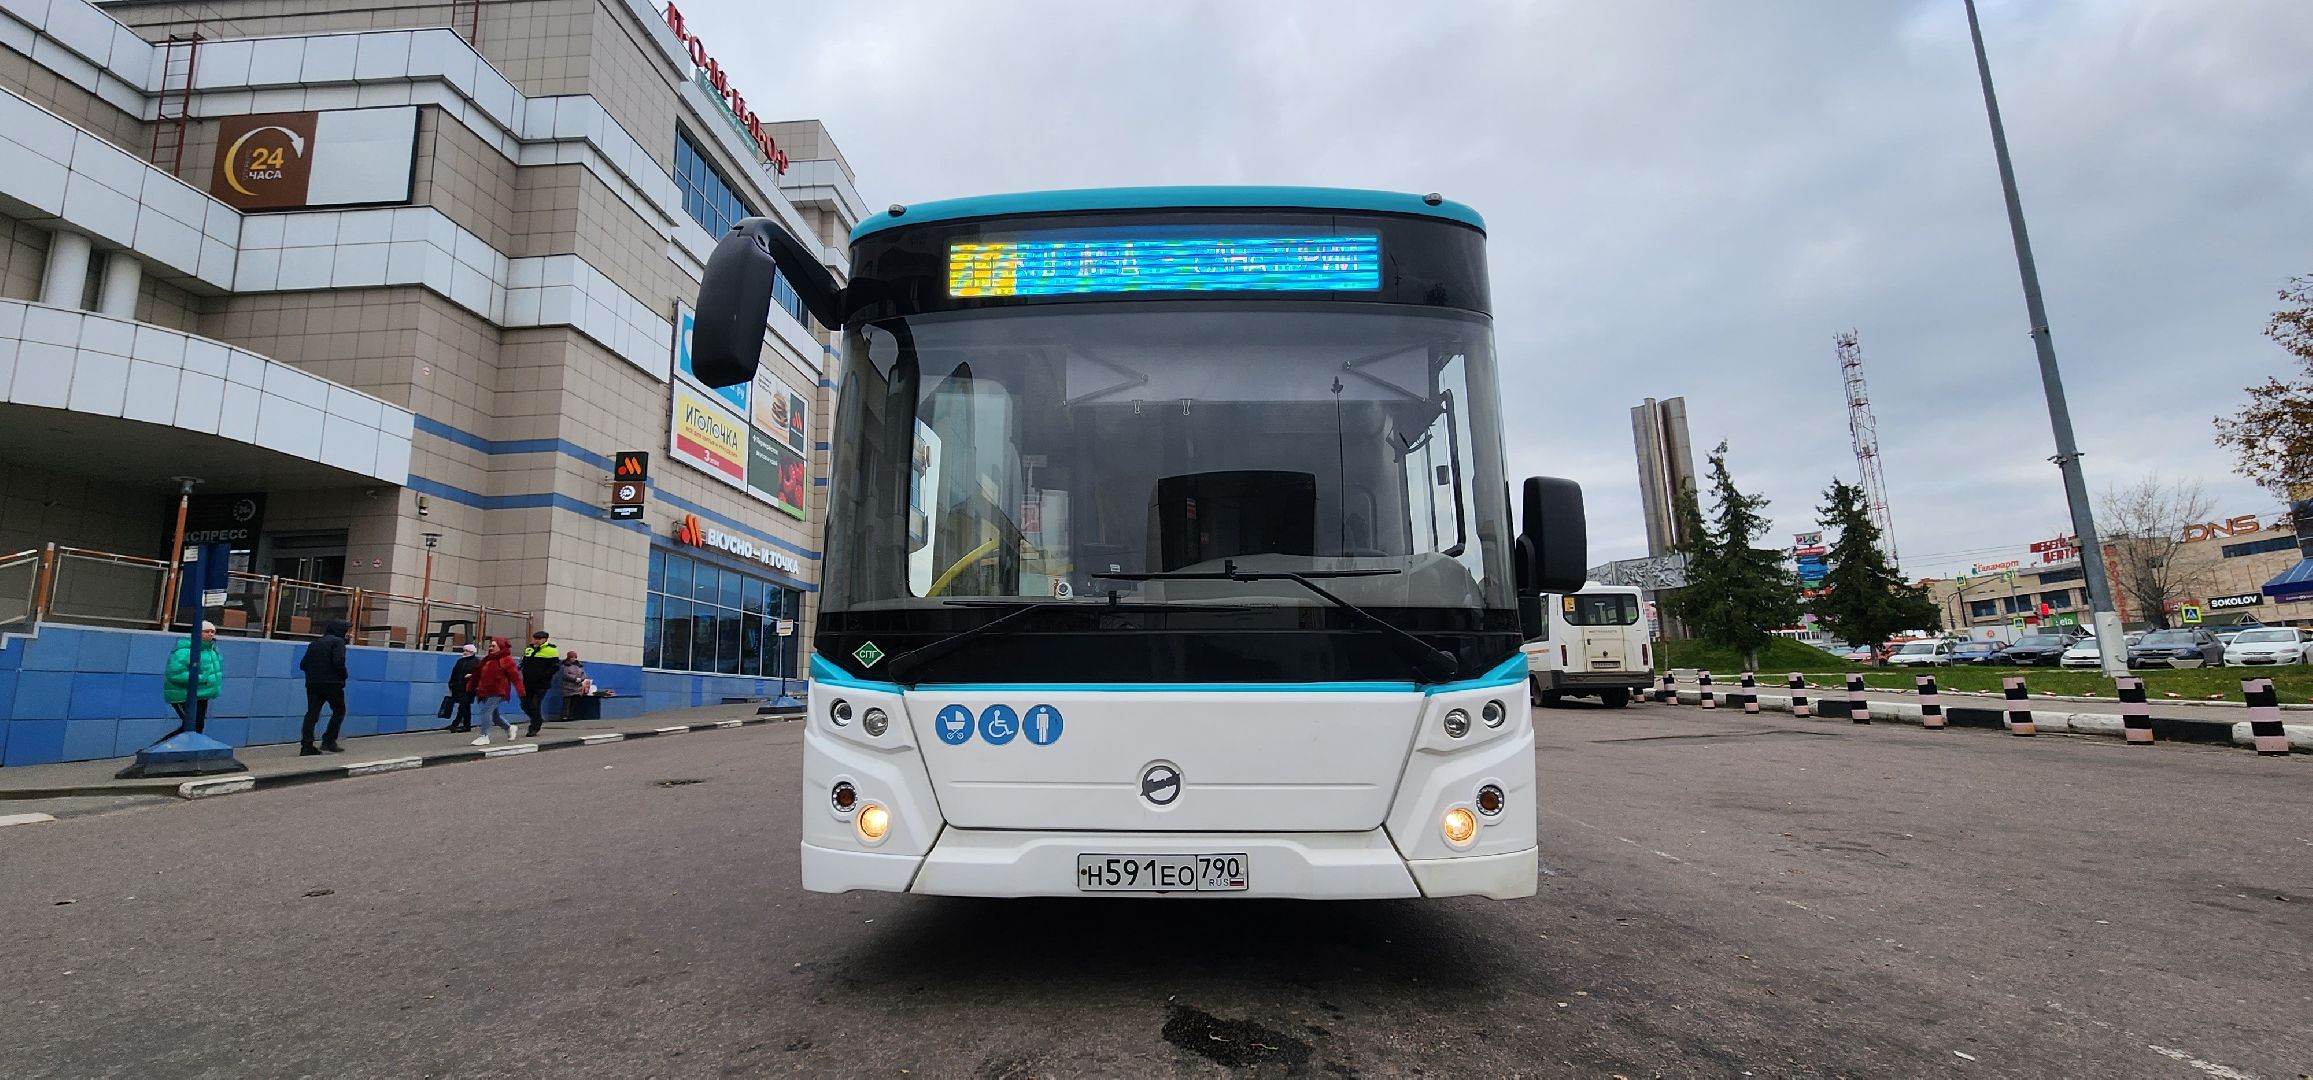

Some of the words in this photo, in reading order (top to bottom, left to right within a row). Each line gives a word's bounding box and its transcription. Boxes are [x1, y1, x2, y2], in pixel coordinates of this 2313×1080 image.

[250, 147, 284, 171] 24
[249, 170, 283, 180] ЧАСА
[703, 449, 711, 462] 3
[184, 529, 248, 541] КСПРЕСС
[2183, 515, 2260, 543] DNS
[707, 528, 752, 558] ВКУСНО
[2211, 594, 2257, 608] SOKOLOV
[859, 650, 877, 658] СПГ
[1199, 857, 1239, 879] 790
[1208, 878, 1229, 887] RUS
